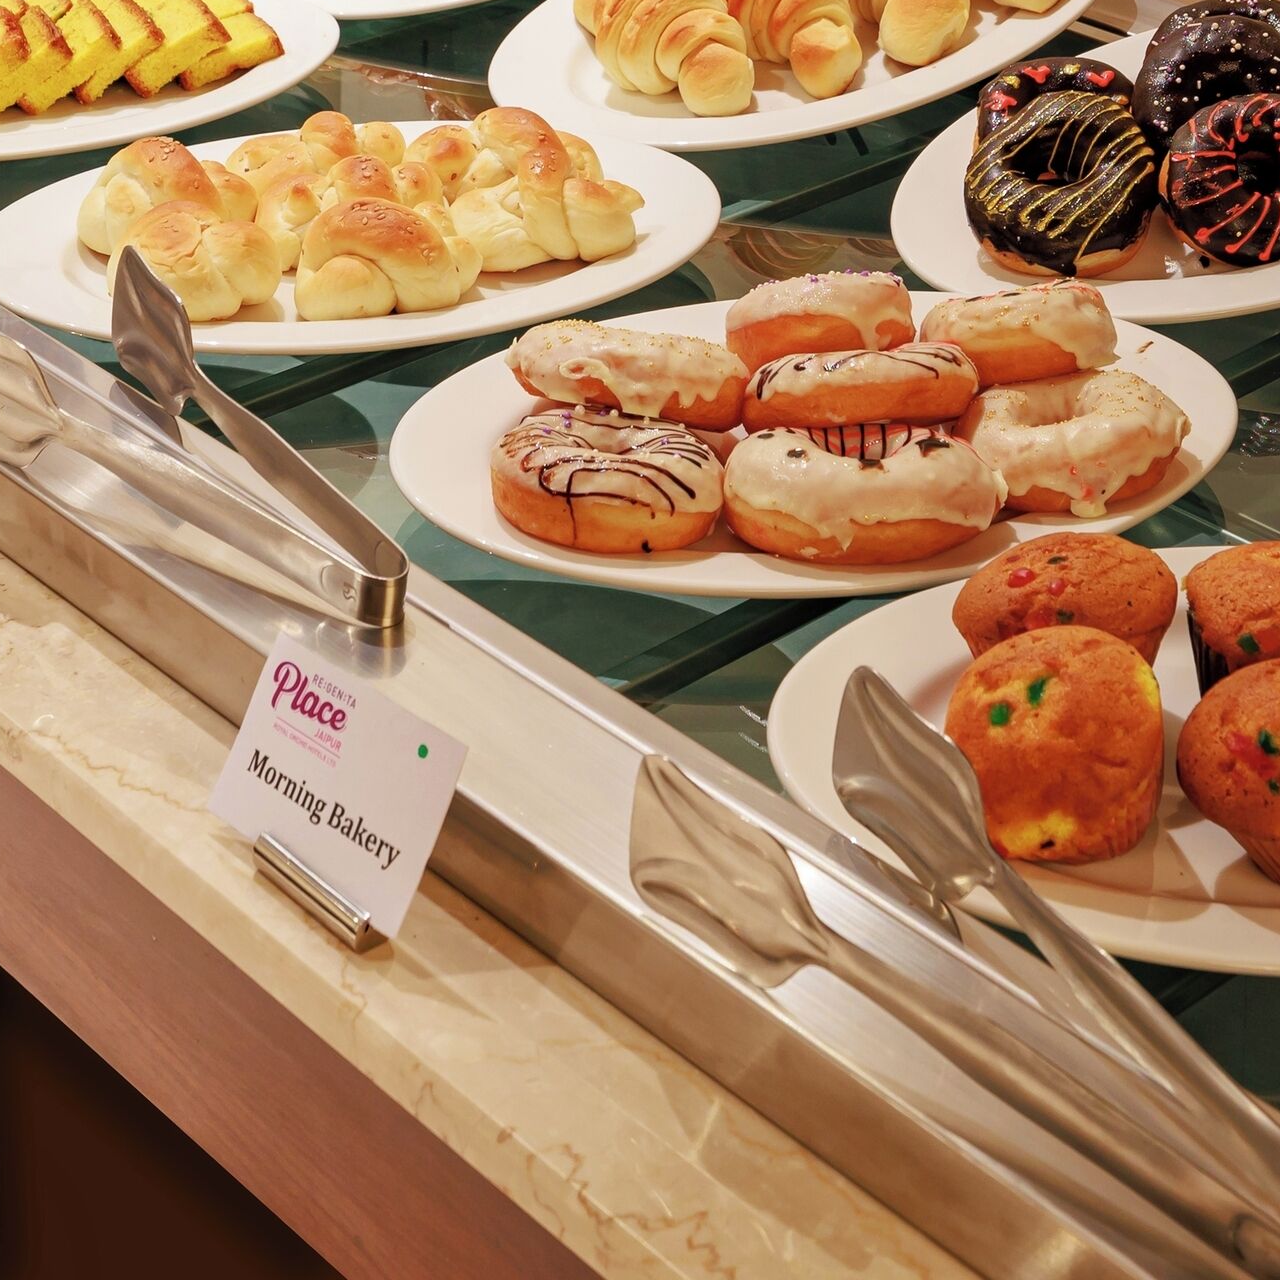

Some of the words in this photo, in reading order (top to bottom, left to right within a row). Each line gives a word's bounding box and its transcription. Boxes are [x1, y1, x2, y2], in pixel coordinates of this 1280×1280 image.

[271, 661, 347, 731] Place
[313, 728, 342, 753] JAIPUR
[247, 748, 327, 825] Morning
[326, 801, 401, 870] Bakery
